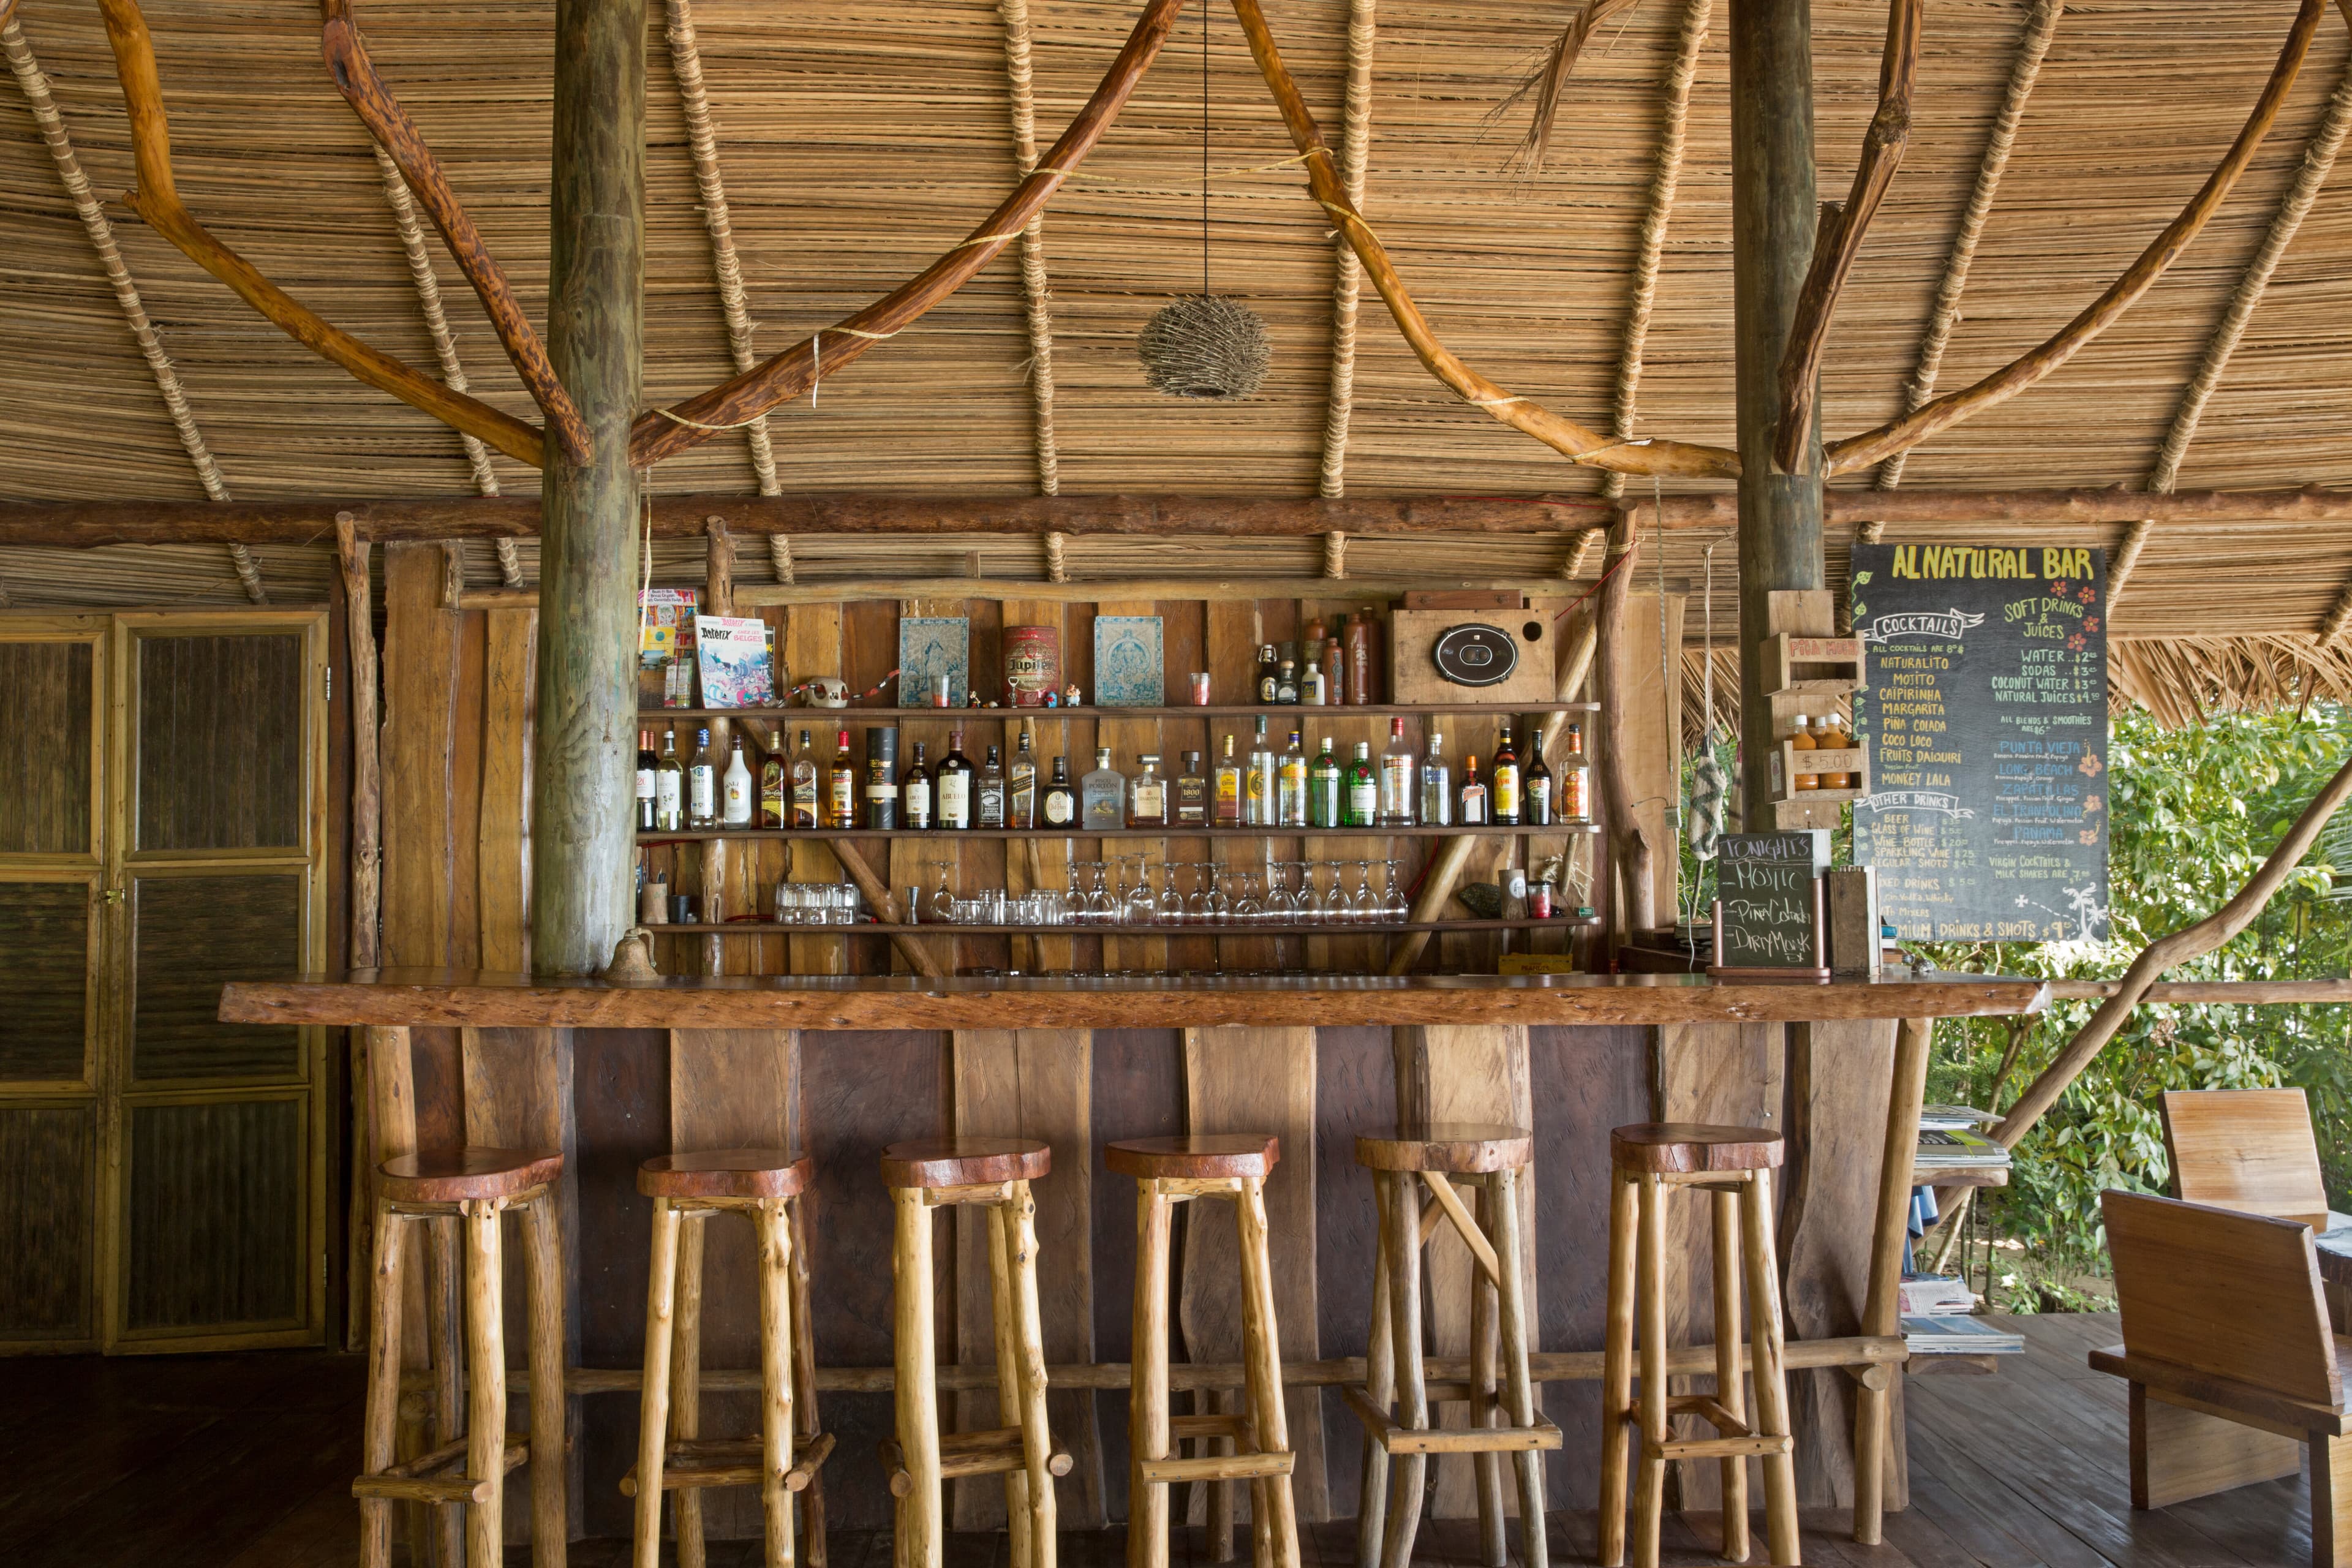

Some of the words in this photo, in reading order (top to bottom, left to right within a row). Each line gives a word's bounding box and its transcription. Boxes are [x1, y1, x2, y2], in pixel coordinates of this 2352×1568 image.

[2043, 547, 2094, 579] BAR
[2004, 597, 2038, 622] SOFT
[2040, 612, 2048, 624] &
[1882, 617, 1958, 636] COCKTAILS
[2021, 649, 2065, 662] WATER
[2021, 665, 2056, 676] SODAS
[1992, 676, 2033, 690] COCONUT
[2036, 677, 2069, 690] WATER
[1995, 690, 2038, 703] NATURAL
[1913, 719, 1947, 732] COLADA
[1882, 733, 1905, 746] COCO
[1910, 734, 1932, 747] LOCO
[2000, 741, 2043, 754] PUNTA
[2047, 741, 2080, 754] VIEJA
[1801, 754, 1813, 771] $
[1999, 763, 2030, 775] LONG
[2035, 764, 2073, 775] BEACH
[1882, 772, 1921, 786] MONKEY
[1926, 772, 1951, 786] LALA
[2002, 783, 2079, 796] ZAPATILLAS
[1872, 794, 1907, 807] OTHER
[1994, 804, 2009, 816] EL
[1884, 814, 1909, 824] BEER
[1871, 822, 1897, 834] GLASS
[1901, 824, 1911, 834] OF
[2013, 827, 2064, 840] PANAMA
[1904, 837, 1936, 847] BOTTLE
[1874, 847, 1926, 858] SPARKLING
[1872, 858, 1911, 867] REGULAR
[1918, 859, 1948, 868] SHOTS
[2064, 858, 2071, 867] &
[1879, 874, 1899, 887] IXED
[1995, 869, 2016, 879] MILK
[2019, 869, 2049, 878] SHAKES
[2052, 869, 2068, 878] ARE
[1891, 919, 1931, 938] MIUM
[1983, 922, 1993, 937] &
[1998, 920, 2036, 938] SHOTS
